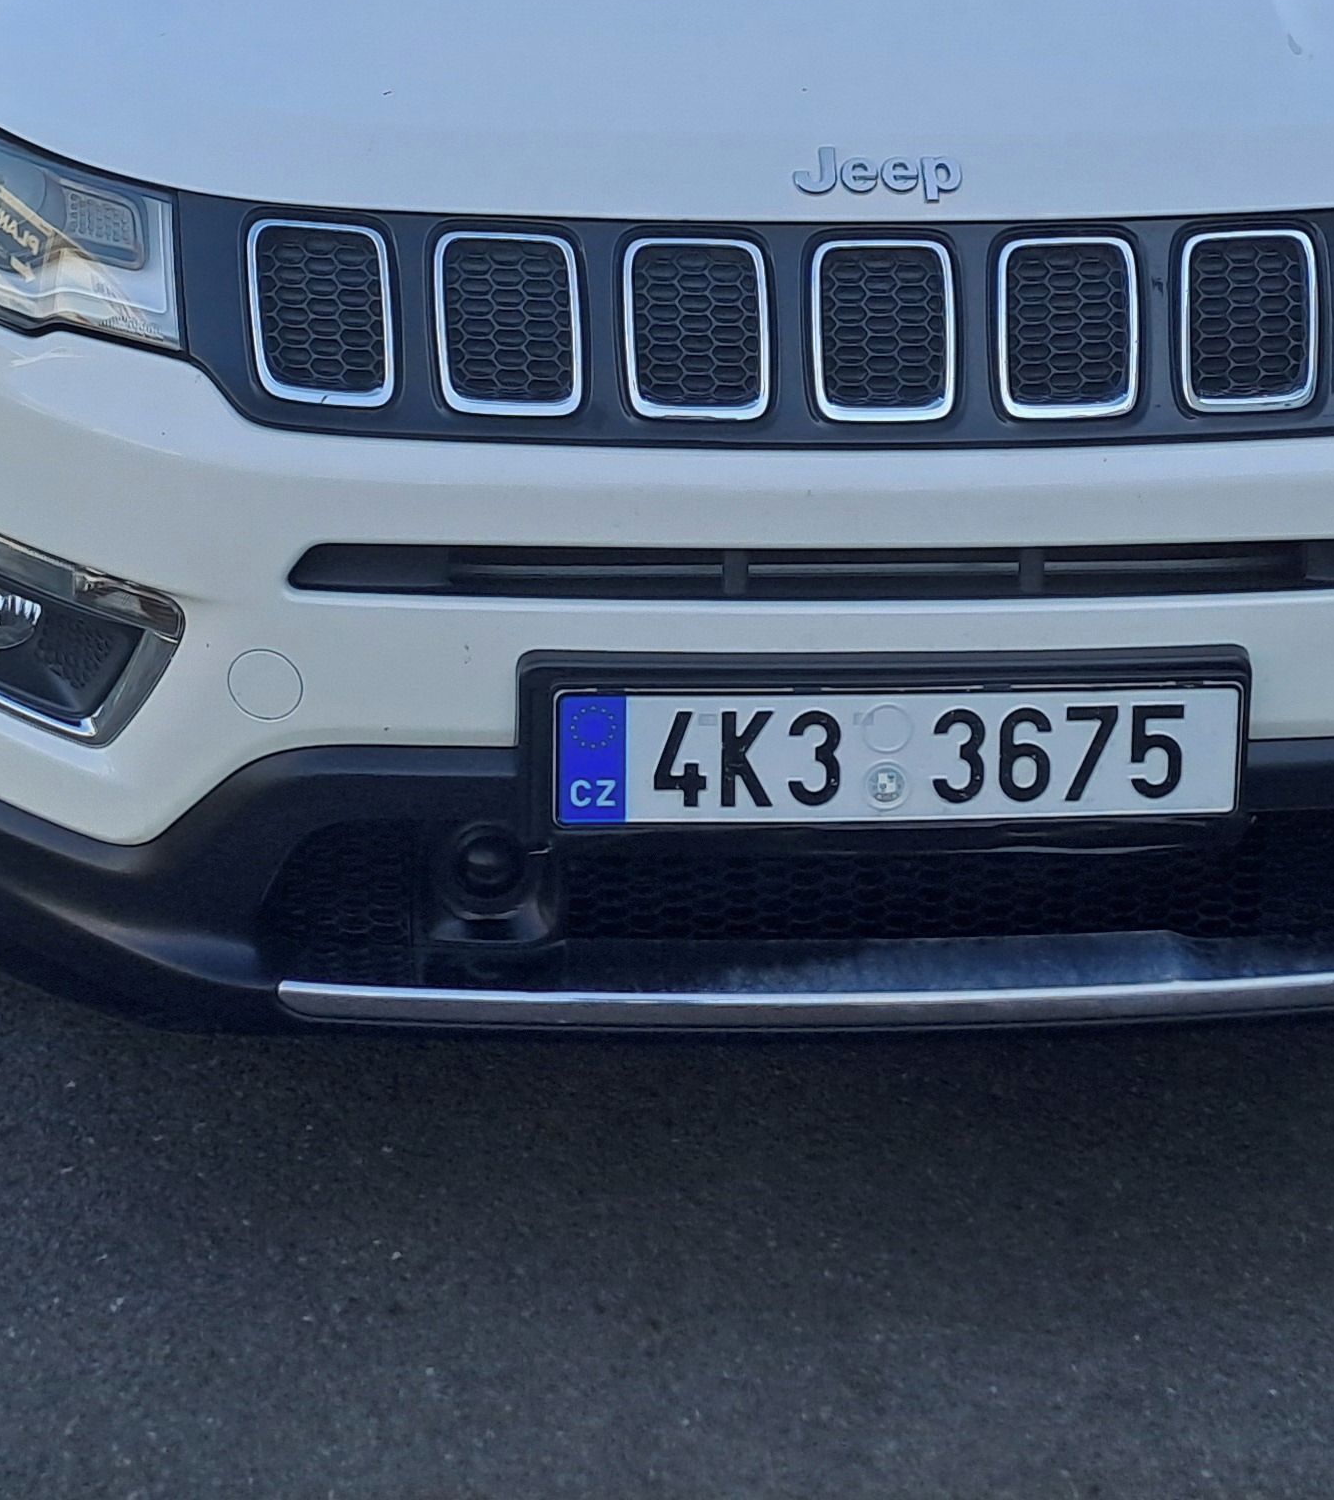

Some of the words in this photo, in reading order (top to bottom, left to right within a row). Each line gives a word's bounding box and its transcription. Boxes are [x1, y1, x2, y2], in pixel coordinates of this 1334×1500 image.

[792, 146, 963, 203] Jeep
[653, 709, 842, 808] 4K3
[932, 704, 1185, 804] 3675
[569, 779, 617, 808] CZ
